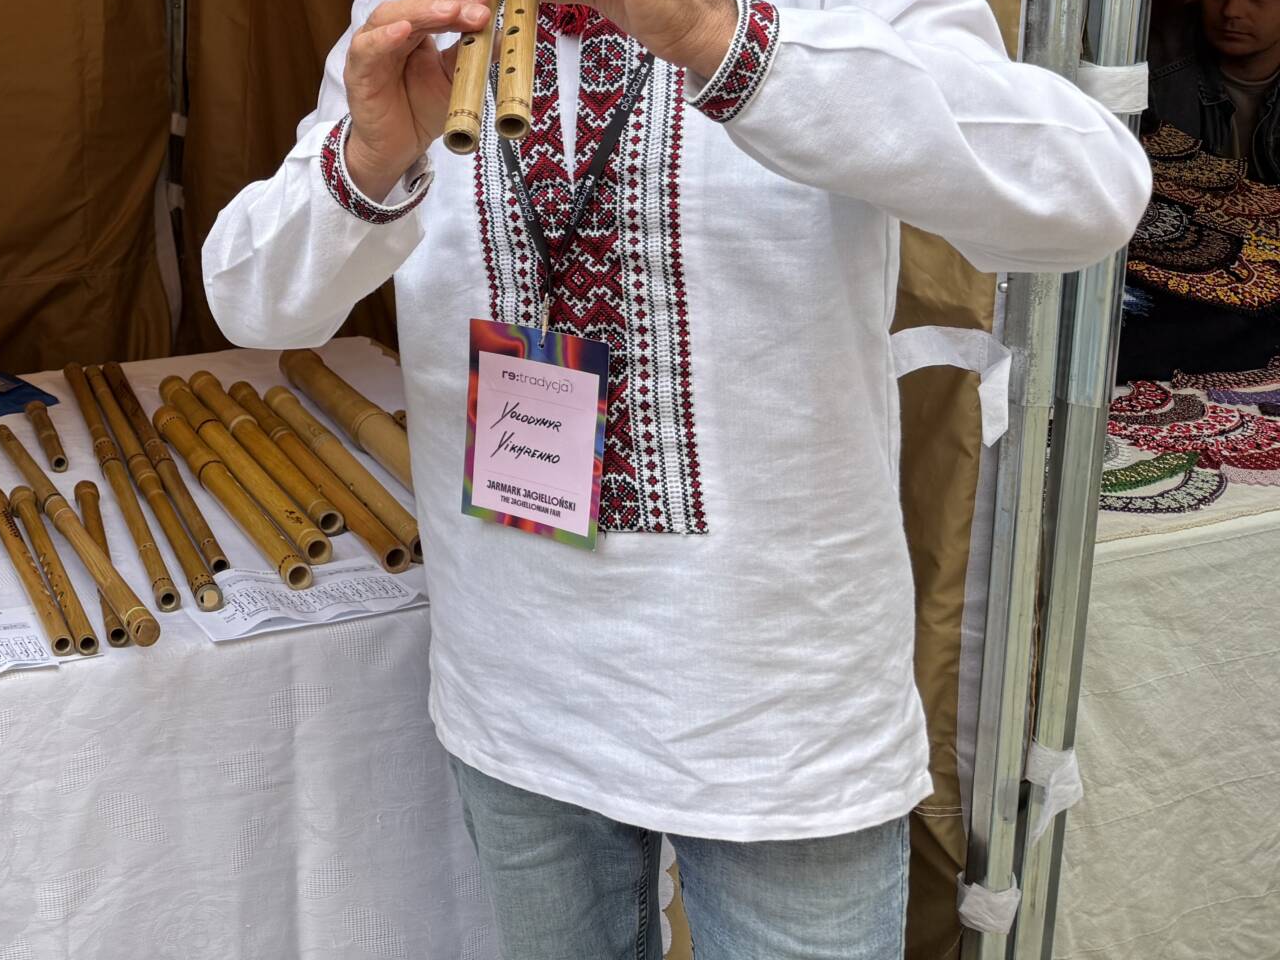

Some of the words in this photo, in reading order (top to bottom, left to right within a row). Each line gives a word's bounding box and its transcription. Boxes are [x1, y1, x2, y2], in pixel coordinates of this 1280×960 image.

[486, 479, 521, 497] JARMARK
[522, 488, 576, 512] JAGIELLOŃSKI
[500, 495, 510, 504] THE
[511, 498, 549, 515] JAGIELLONIAN
[549, 508, 561, 518] FAIR
